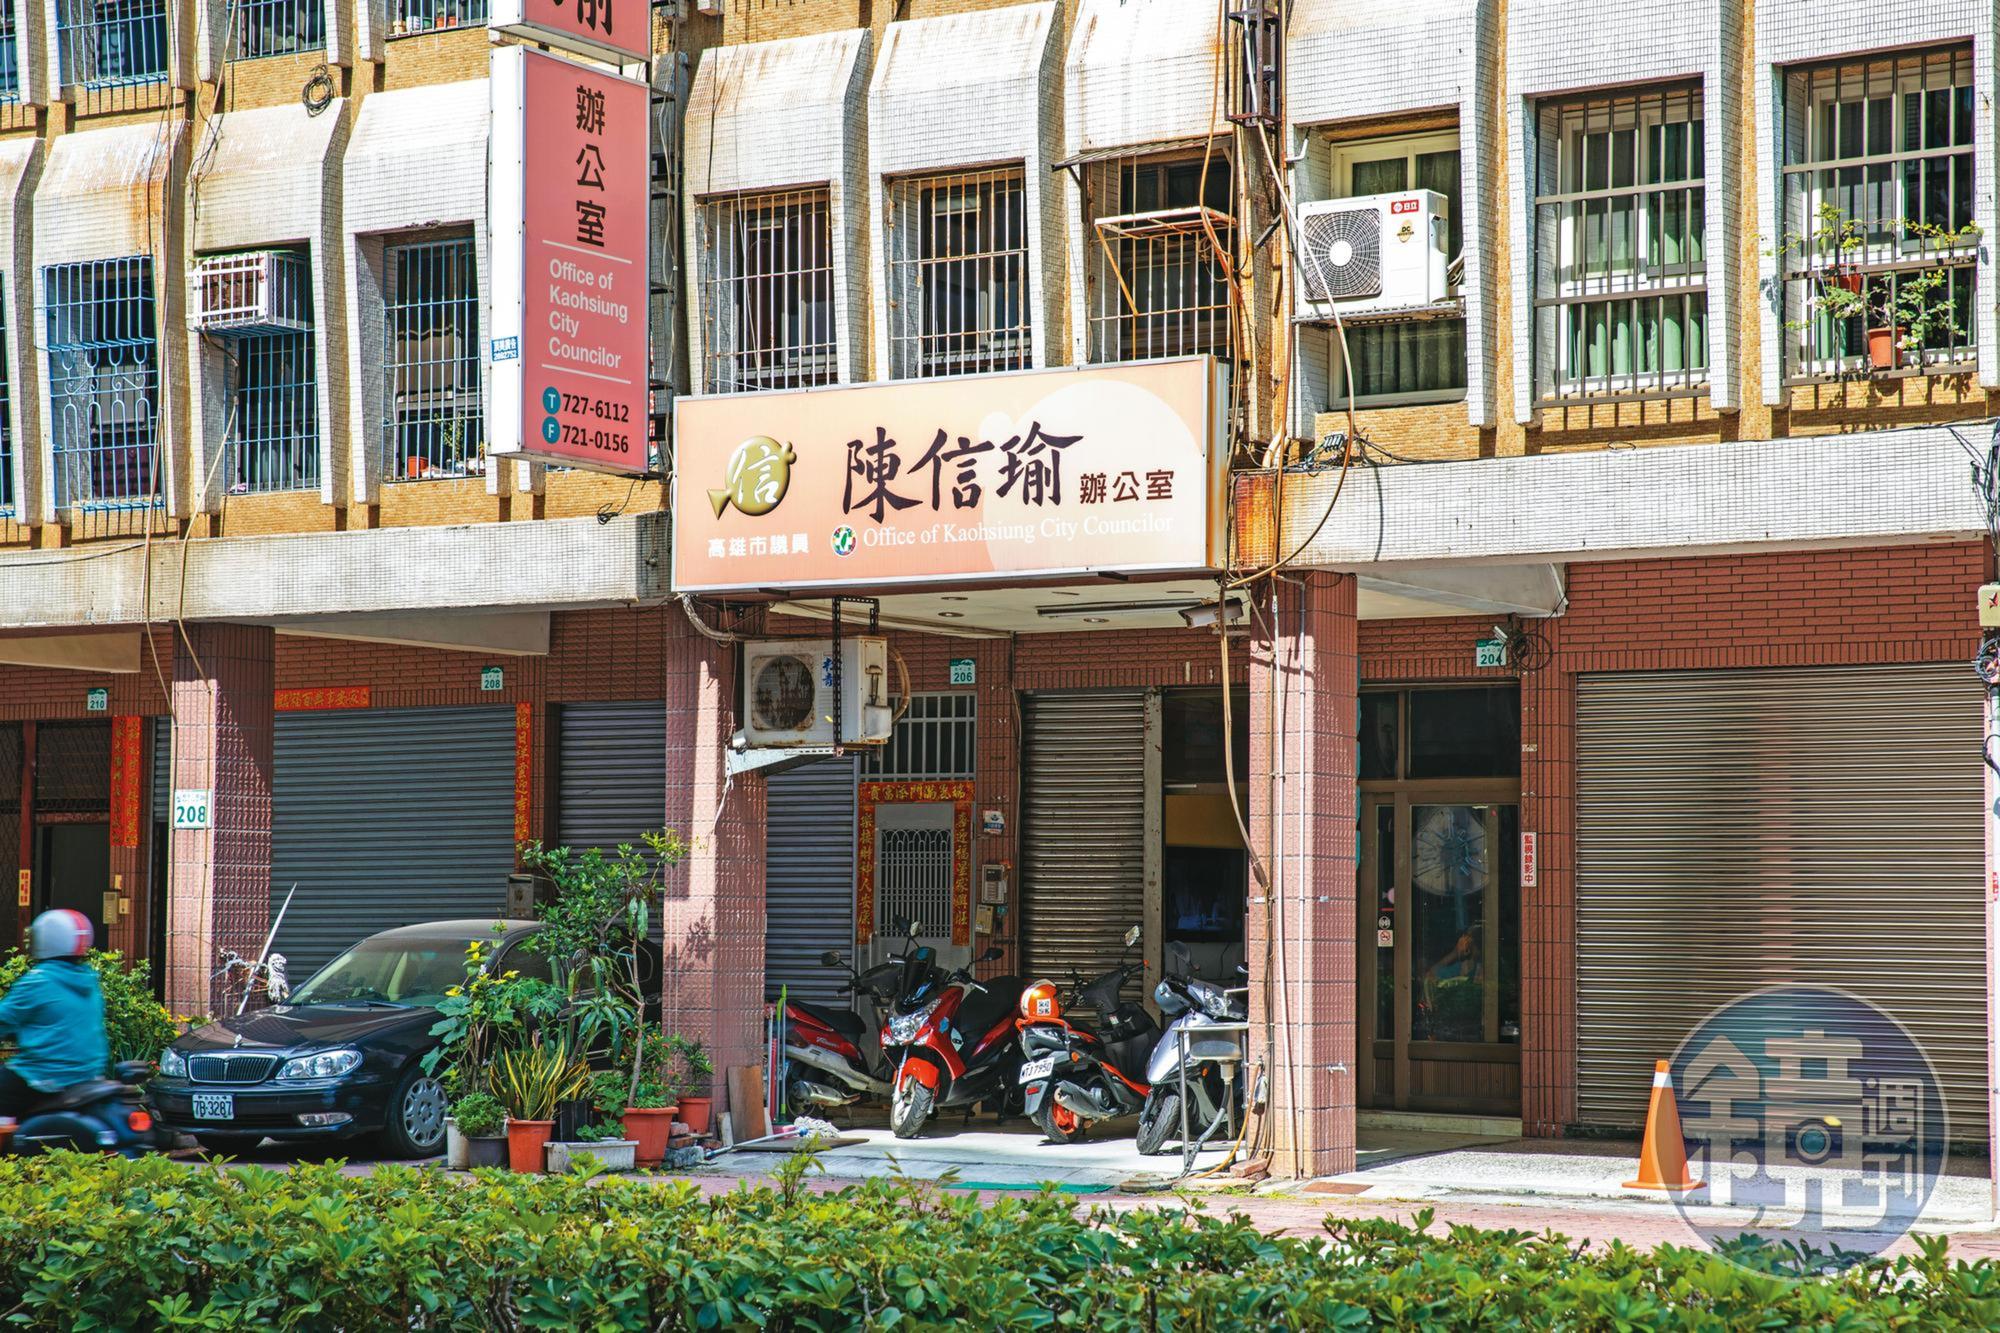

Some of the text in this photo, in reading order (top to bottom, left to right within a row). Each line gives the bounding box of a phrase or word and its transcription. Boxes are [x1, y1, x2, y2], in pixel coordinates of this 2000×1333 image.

[575, 84, 606, 248] 辦公室
[549, 258, 614, 290] Office of
[549, 284, 628, 324] Kaohsiung
[549, 310, 580, 338] City
[548, 336, 622, 369] Councilor
[548, 393, 629, 423] T 727-6112
[548, 423, 629, 453] F 721-0156
[732, 445, 779, 504] 信
[842, 420, 1084, 524] 陳信瑜
[1079, 468, 1174, 504] 辦公室
[863, 512, 1174, 548] Office of Kaohsiung City Councilor
[707, 533, 809, 559] 高雄市議員
[1480, 653, 1503, 665] 204
[484, 680, 501, 688] 208
[953, 672, 973, 682] 206
[90, 700, 105, 709] 210
[176, 805, 207, 823] 208
